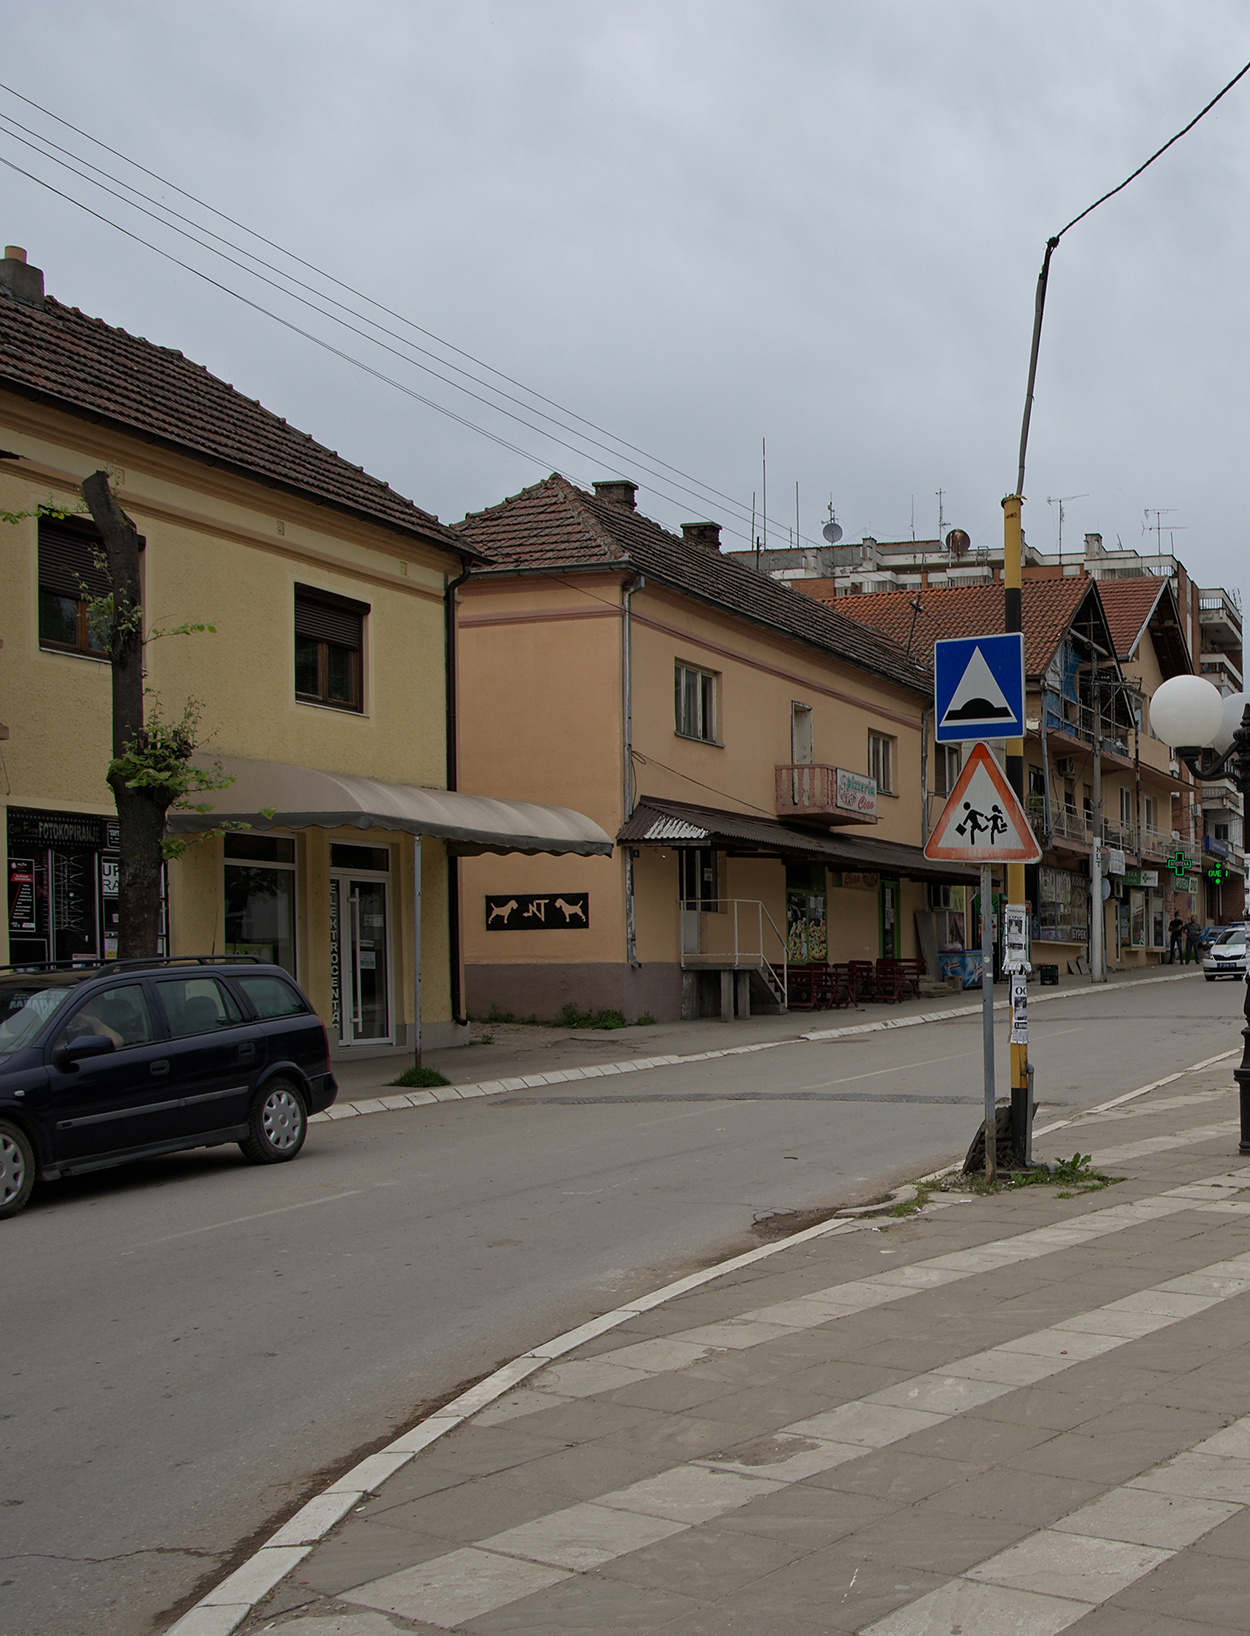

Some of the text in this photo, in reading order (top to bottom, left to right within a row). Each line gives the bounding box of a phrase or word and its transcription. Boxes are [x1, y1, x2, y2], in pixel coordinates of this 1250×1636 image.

[846, 774, 875, 796] pizzeria
[857, 795, 874, 809] Ciao
[38, 821, 100, 843] FOTOKOPIRANJE
